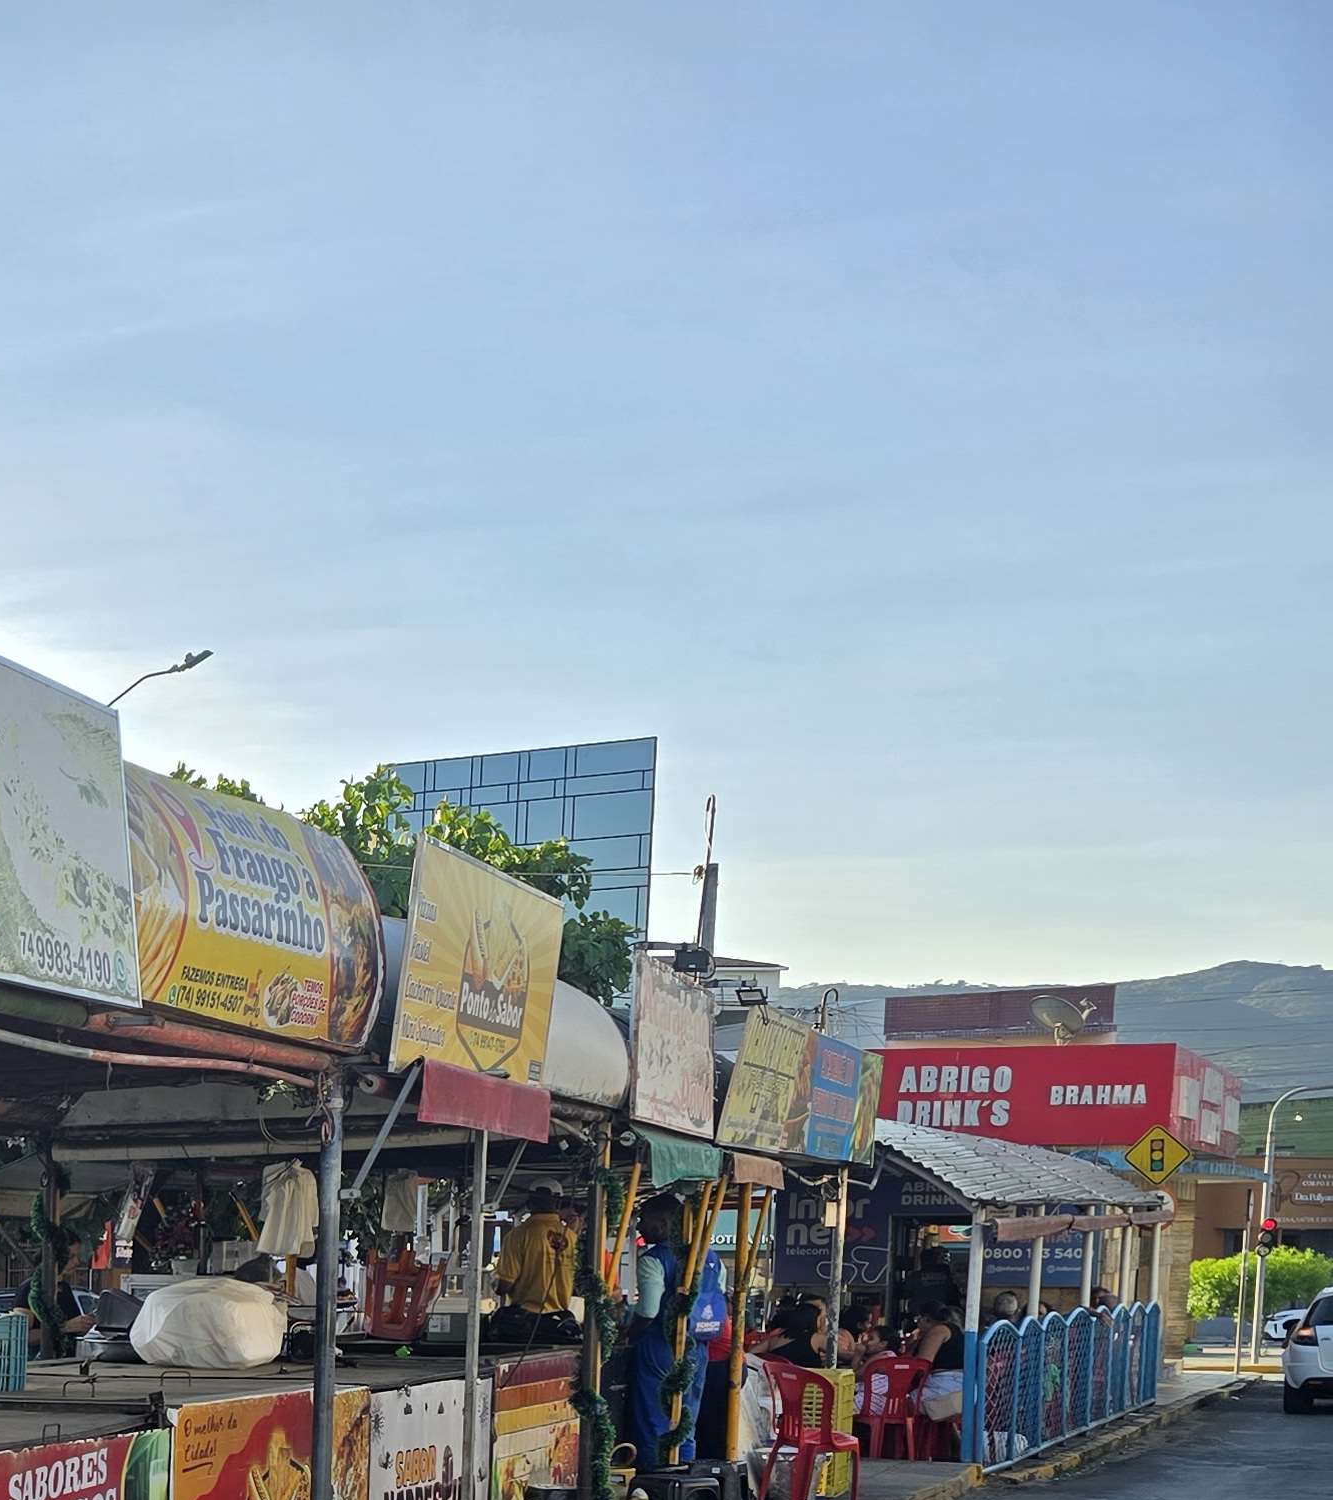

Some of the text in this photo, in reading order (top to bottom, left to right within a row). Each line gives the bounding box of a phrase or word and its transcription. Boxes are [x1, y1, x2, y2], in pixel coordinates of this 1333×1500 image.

[206, 828, 301, 900] Frango
[195, 871, 327, 953] Passarinho
[19, 932, 112, 984] 74 9983-4190
[181, 966, 249, 992] FAZEMOS ENTREGA
[460, 982, 489, 1019] Ponto
[496, 993, 523, 1029] Sabor
[898, 1065, 1013, 1094] ABRIGO
[1049, 1083, 1148, 1106] BRAHMA
[786, 1246, 830, 1256] telecom
[984, 1247, 1094, 1259] 0800 13 540
[184, 1418, 192, 1438] O
[194, 1414, 226, 1436] melhor
[396, 1445, 437, 1489] SABOR
